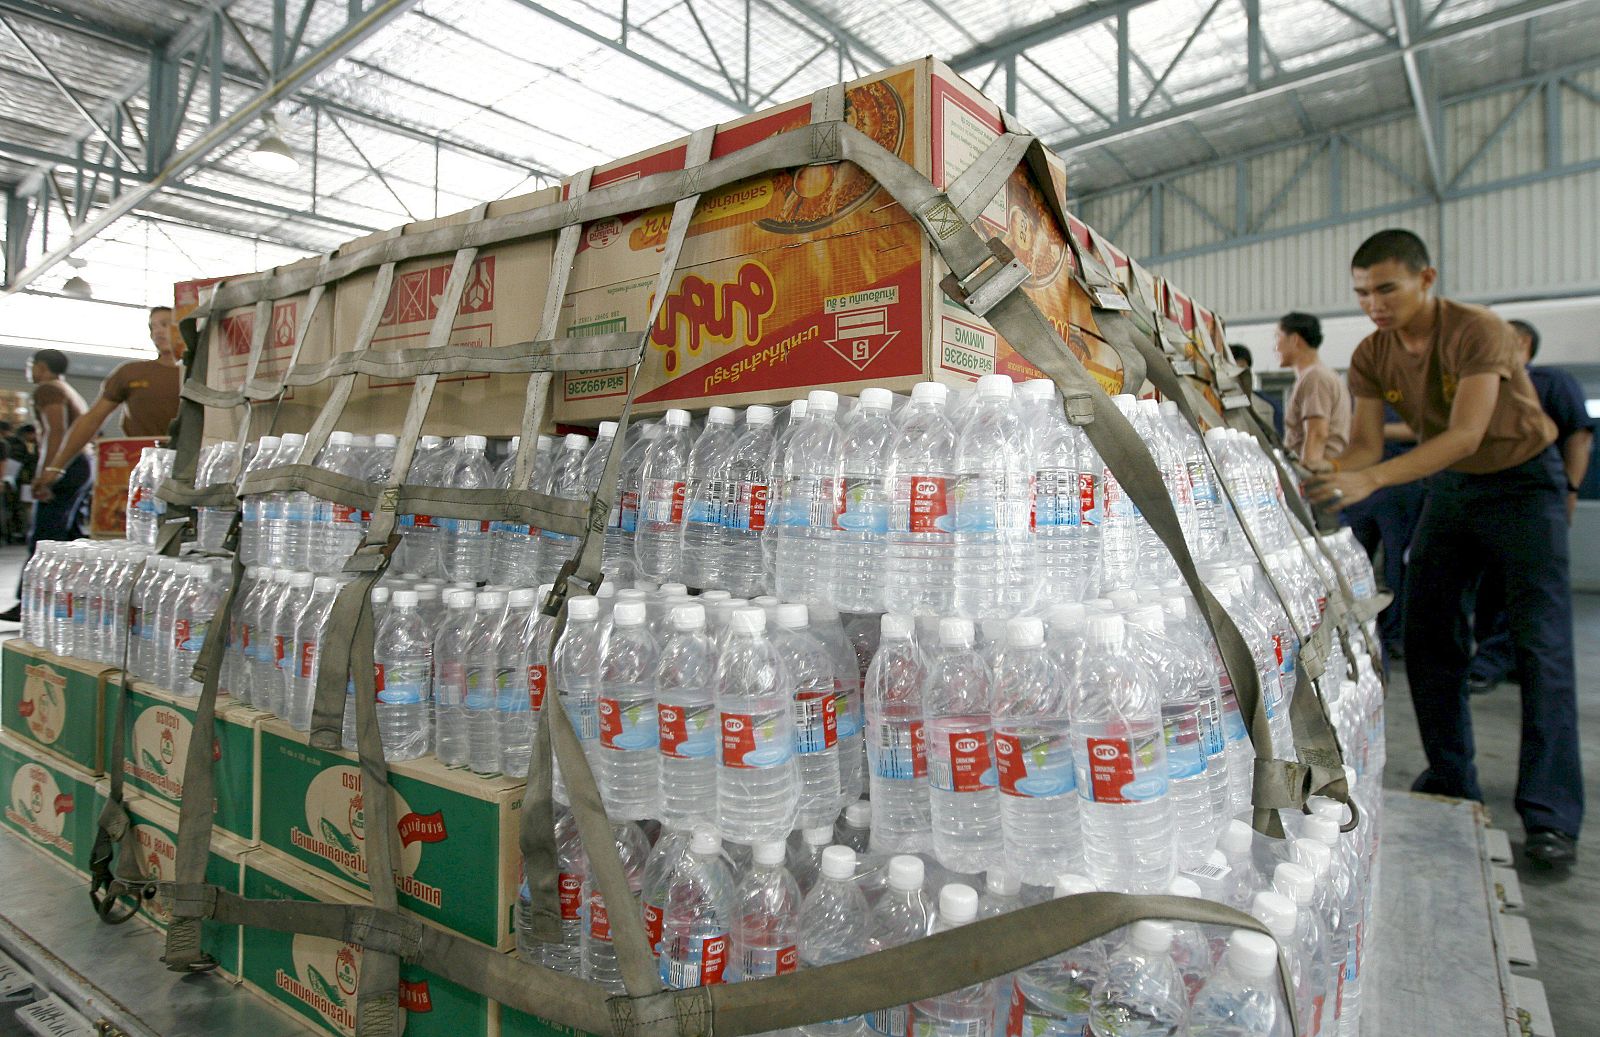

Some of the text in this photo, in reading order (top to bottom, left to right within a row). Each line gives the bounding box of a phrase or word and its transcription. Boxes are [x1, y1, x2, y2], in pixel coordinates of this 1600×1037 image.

[589, 227, 620, 242] Thailand
[839, 297, 847, 308] 5
[955, 327, 985, 350] MMWG
[856, 341, 866, 358] 5
[944, 347, 979, 370] 499236
[568, 379, 606, 395] 499236
[726, 720, 741, 728] aro
[957, 740, 976, 749] aro
[1095, 747, 1116, 757] aro
[709, 943, 723, 952] aro
